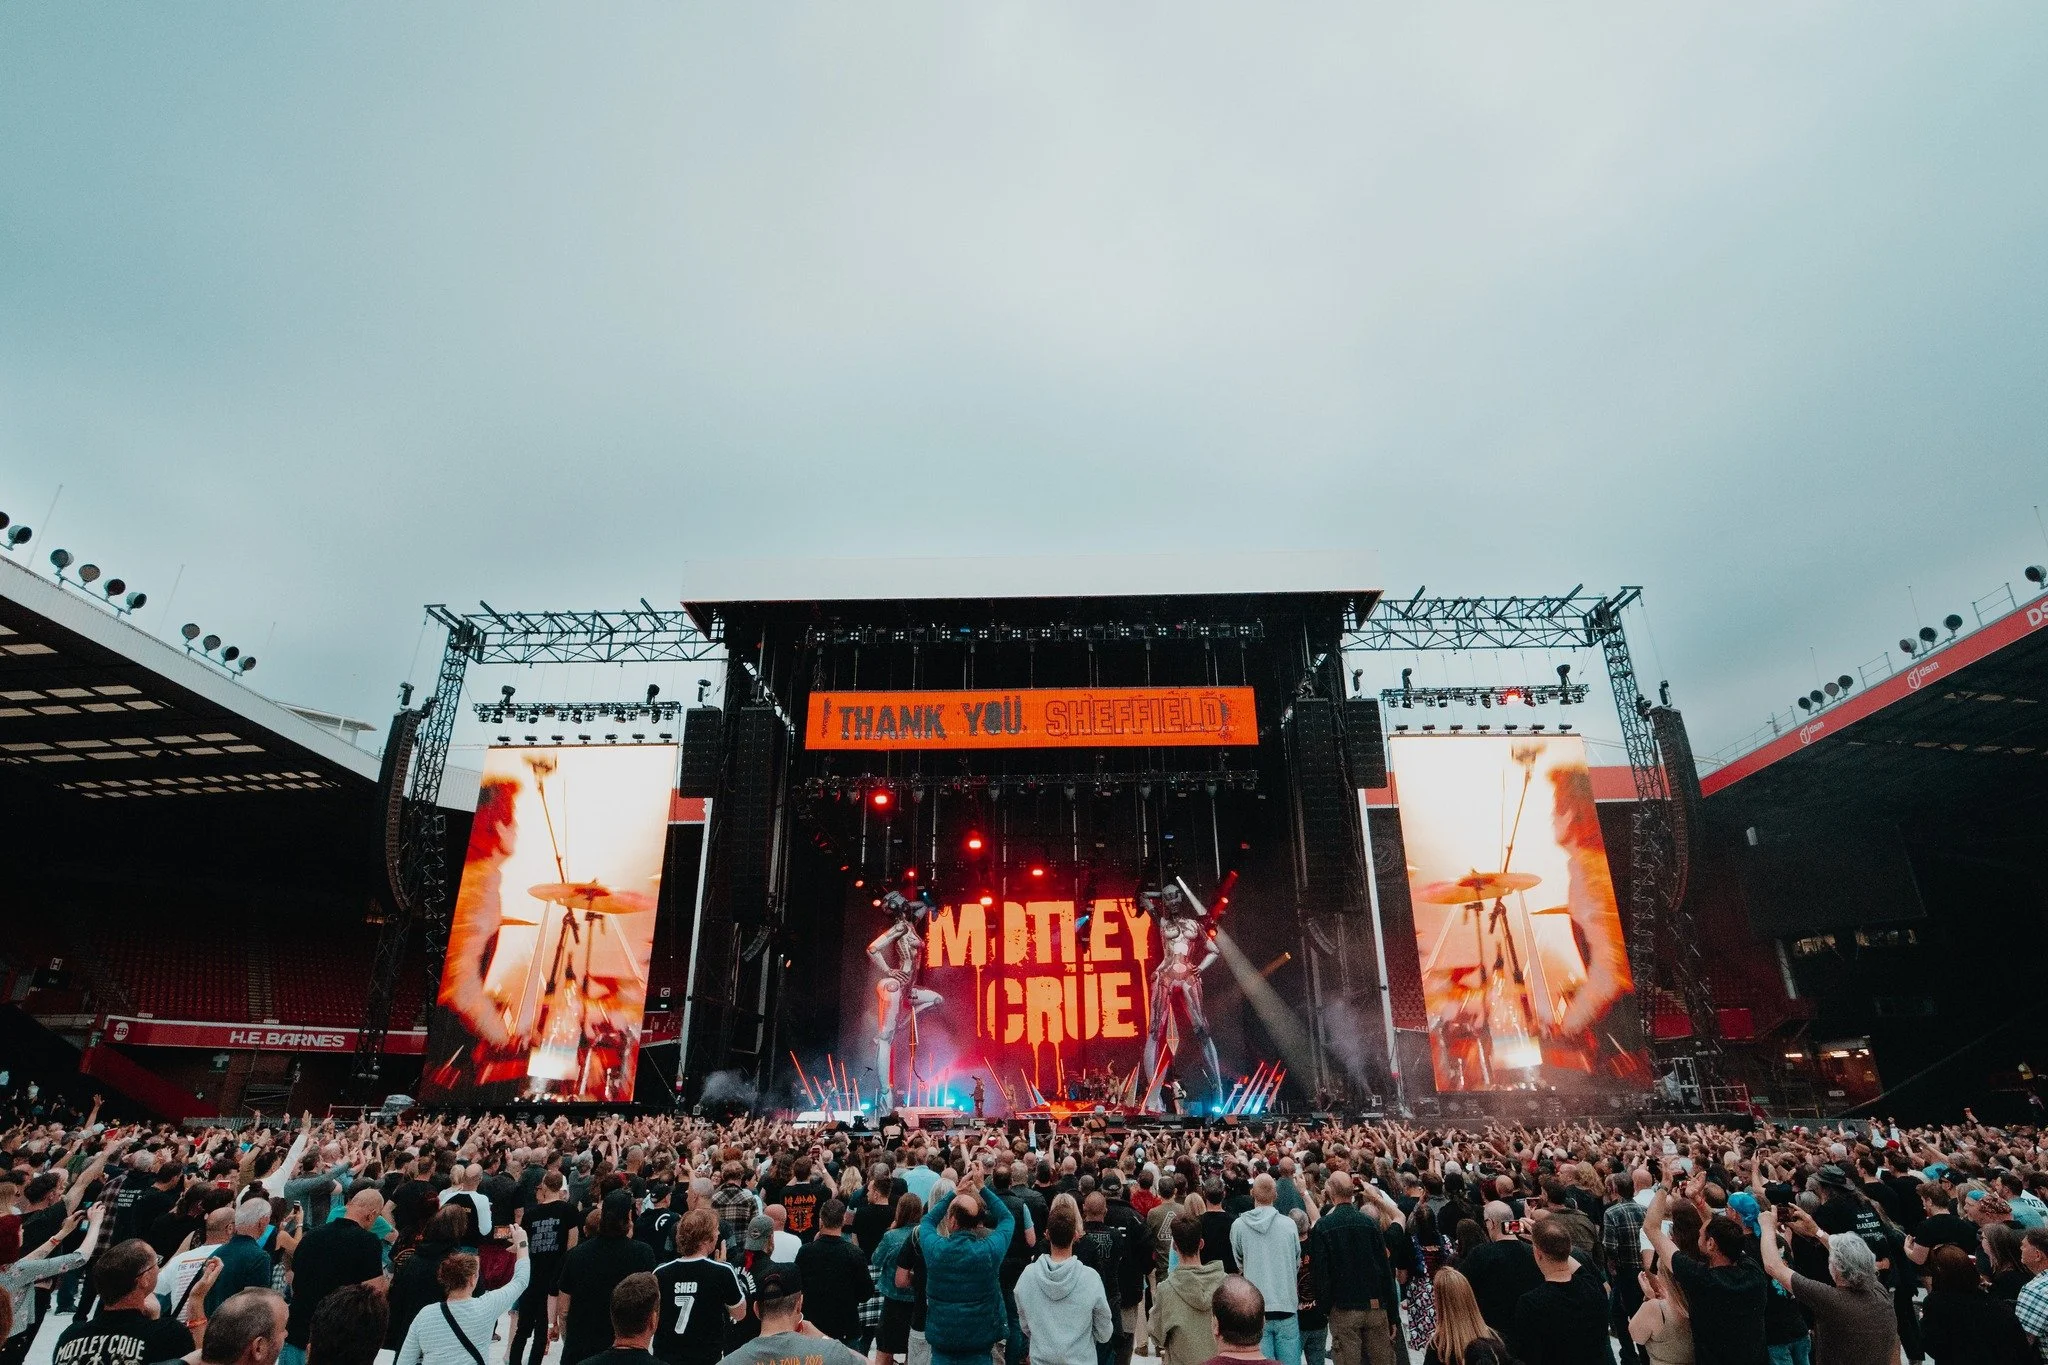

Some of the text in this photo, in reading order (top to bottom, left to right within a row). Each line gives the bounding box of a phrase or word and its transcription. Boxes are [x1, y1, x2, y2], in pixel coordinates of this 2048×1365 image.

[838, 703, 947, 741] THANK
[1045, 697, 1224, 737] SHEFFIELD
[229, 1031, 345, 1047] H.E.BARNES
[674, 1282, 698, 1294] SHED
[674, 1295, 695, 1335] 7
